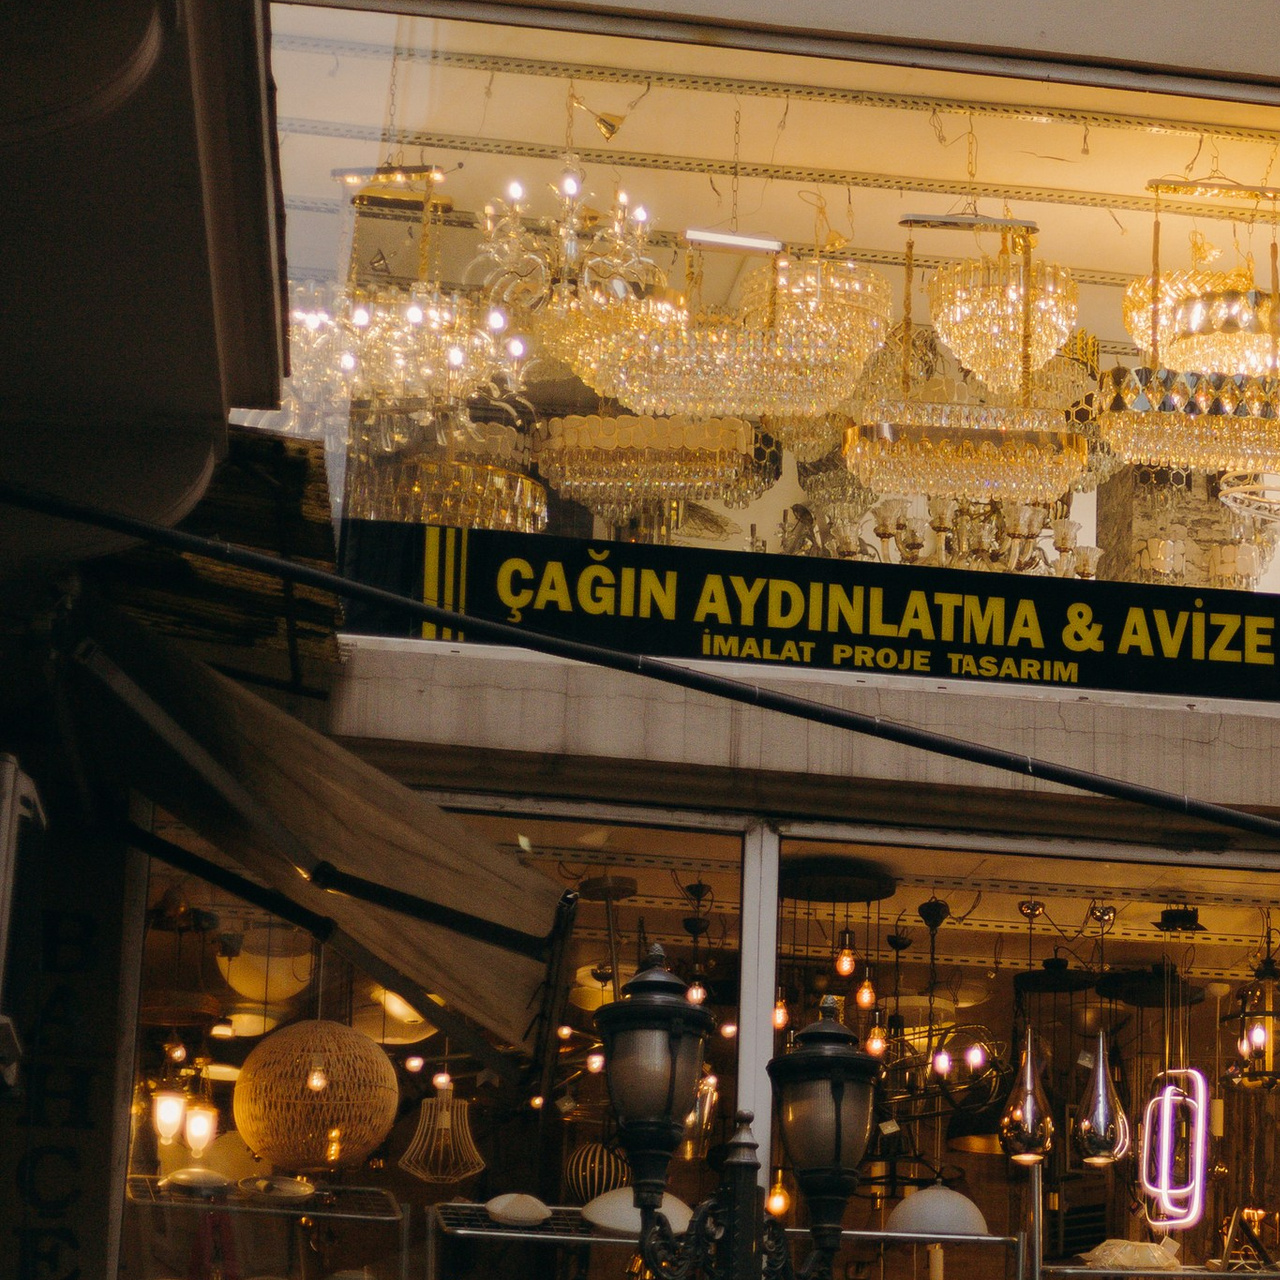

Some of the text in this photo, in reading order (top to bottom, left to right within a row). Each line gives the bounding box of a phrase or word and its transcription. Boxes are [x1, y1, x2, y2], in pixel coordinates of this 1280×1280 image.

[497, 548, 1275, 666] ÇAĞIN AYDINLATMA & AVİZE
[702, 628, 1078, 683] İMALAT PROJE TASARIM
